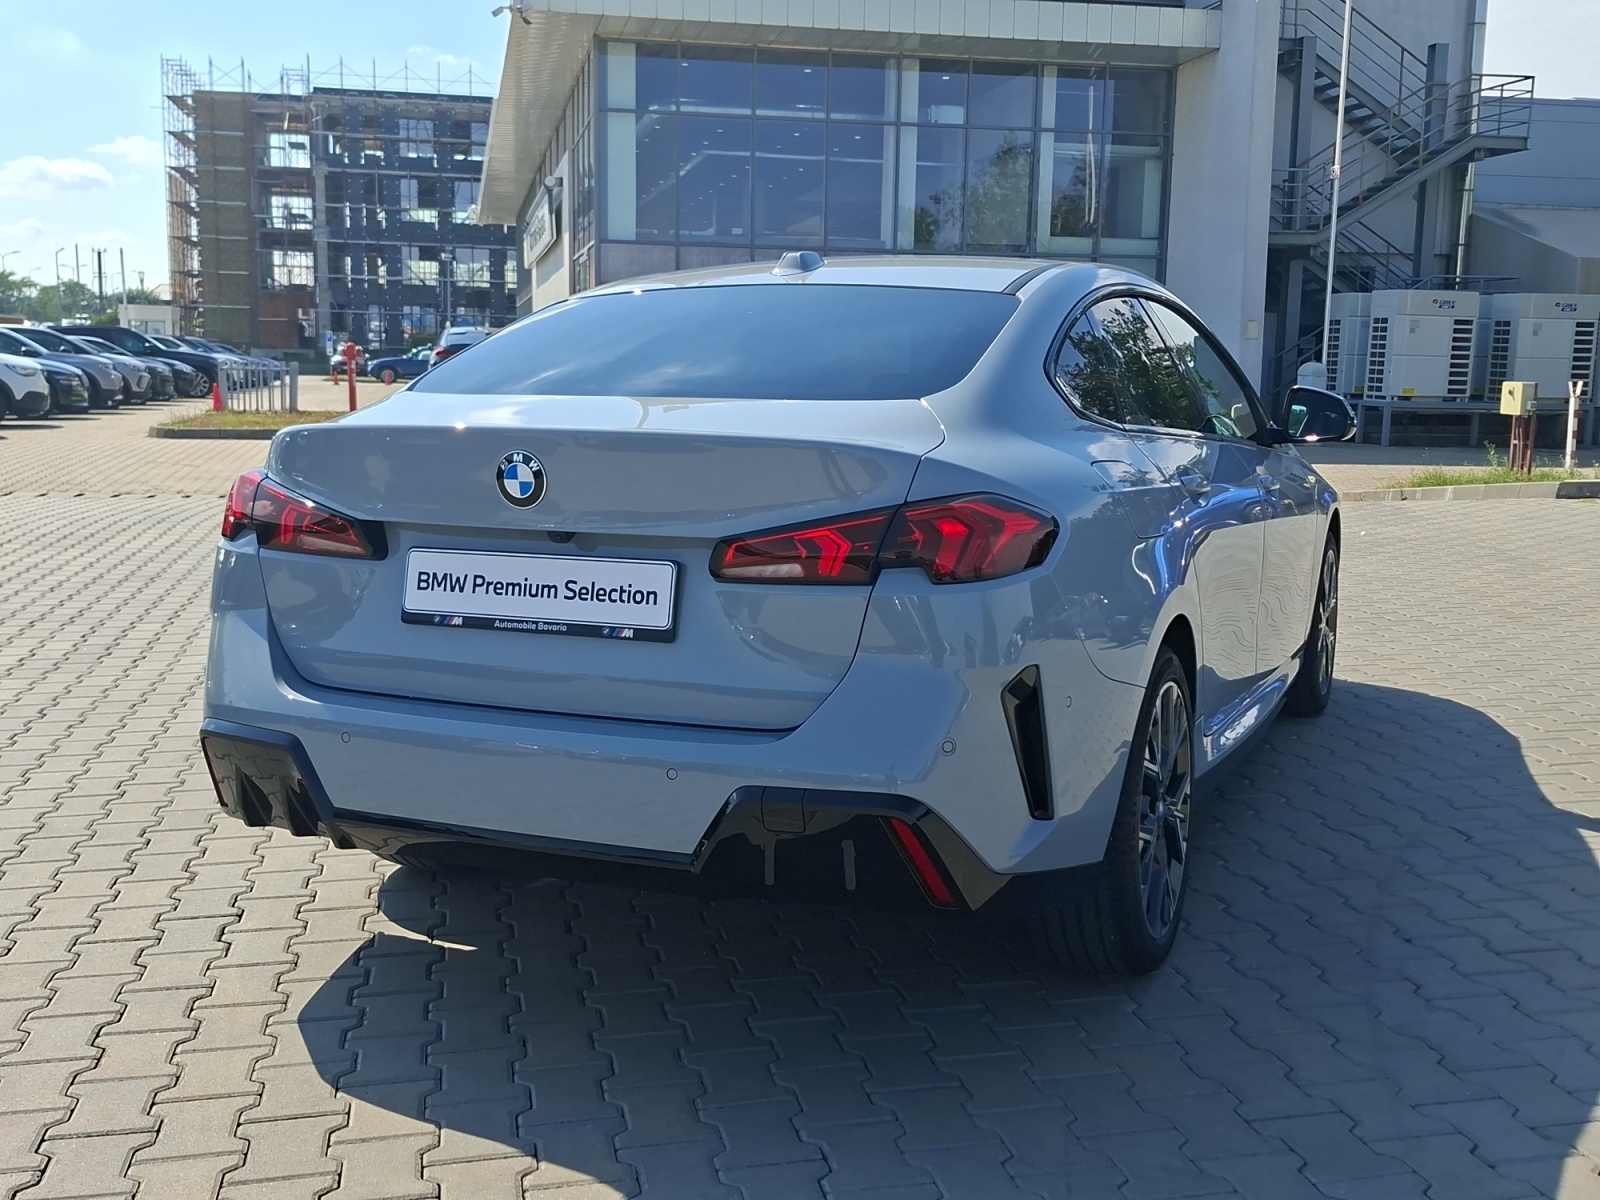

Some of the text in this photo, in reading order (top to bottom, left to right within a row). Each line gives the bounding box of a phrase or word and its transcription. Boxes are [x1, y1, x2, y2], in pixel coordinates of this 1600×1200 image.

[500, 453, 540, 471] BMW
[416, 571, 658, 605] BMW Premium Selection
[494, 620, 567, 631] Automobile Bavaria
